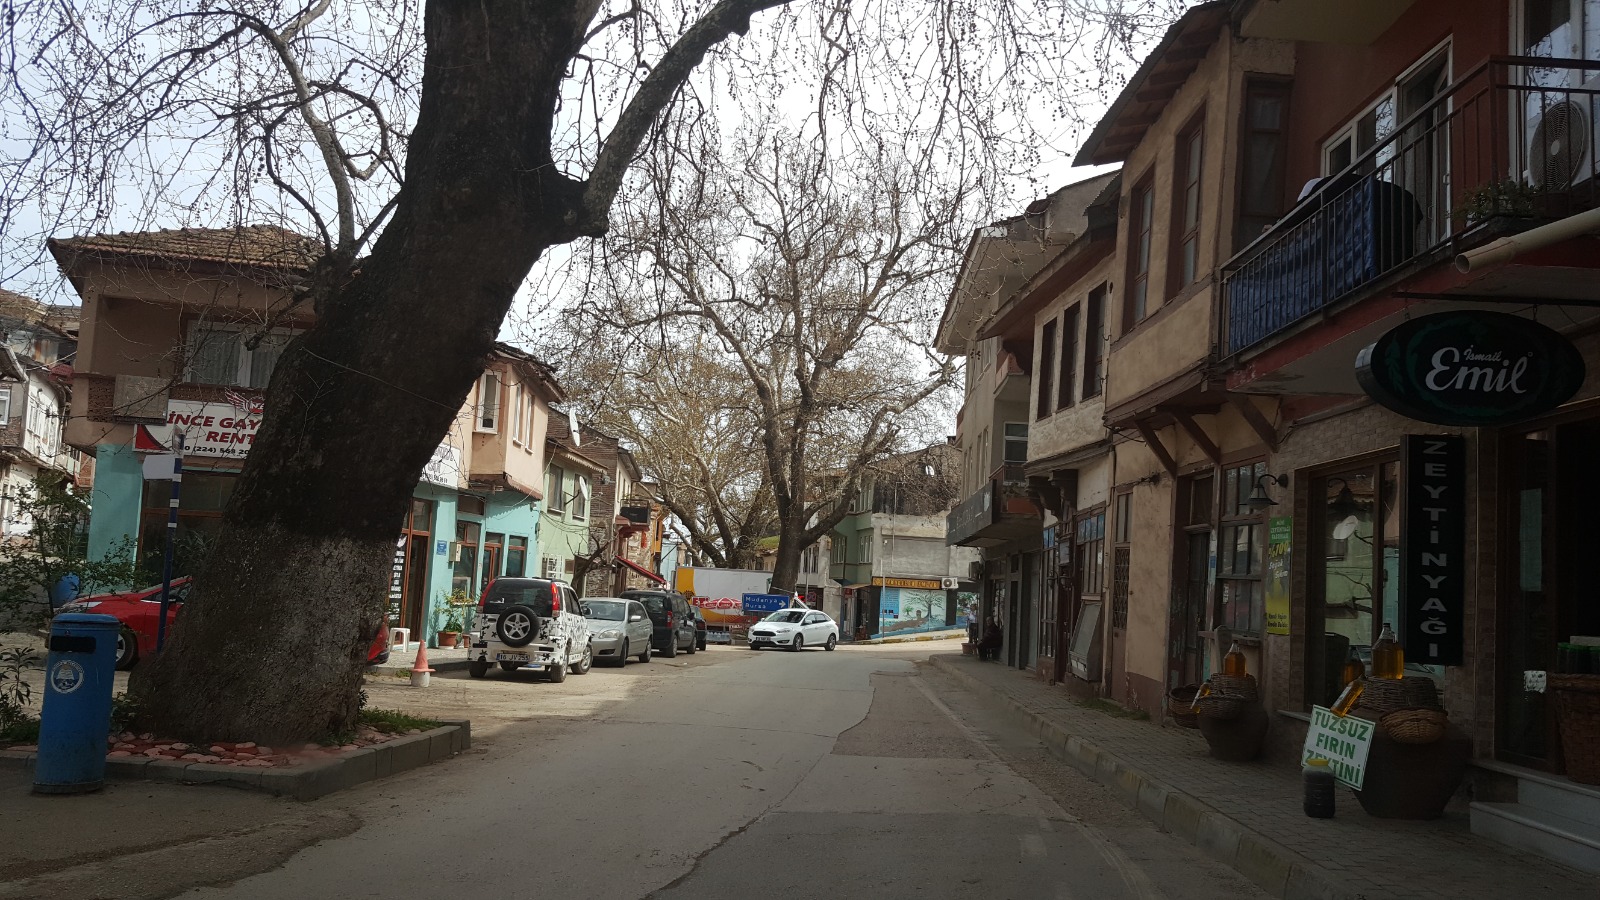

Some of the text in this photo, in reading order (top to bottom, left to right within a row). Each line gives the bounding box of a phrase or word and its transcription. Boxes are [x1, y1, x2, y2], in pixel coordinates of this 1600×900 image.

[1425, 346, 1528, 394] Emil
[167, 411, 262, 430] İNCE GAY
[206, 431, 256, 444] RENT
[1420, 440, 1449, 657] ZEYTİNYAĞI
[745, 596, 778, 604] Mudanya
[1314, 711, 1370, 741] TUZSUZ
[1316, 733, 1356, 759] FIRIN
